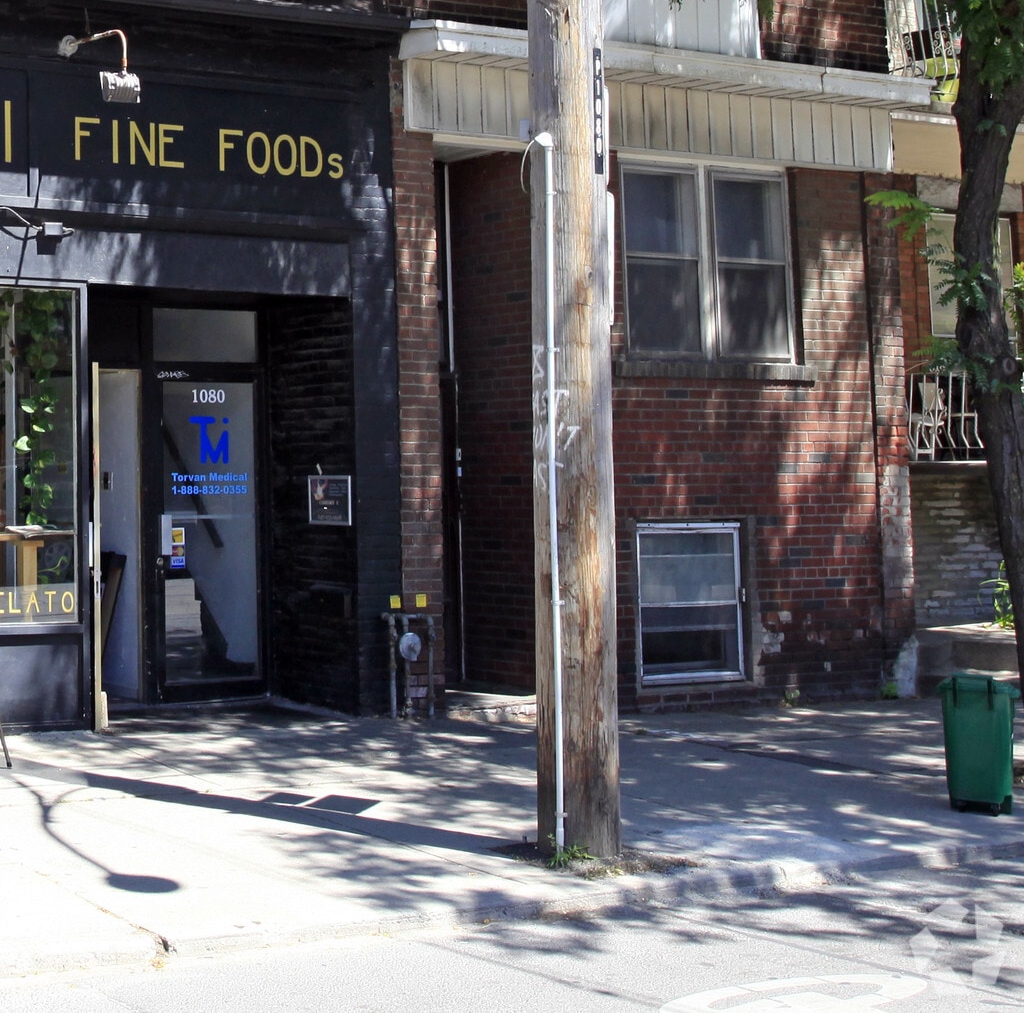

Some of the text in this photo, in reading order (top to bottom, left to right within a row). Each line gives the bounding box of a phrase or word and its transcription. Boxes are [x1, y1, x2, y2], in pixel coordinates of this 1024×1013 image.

[74, 116, 185, 168] FINE
[191, 389, 226, 404] 1080
[171, 472, 249, 482] Torvan Medical
[171, 485, 249, 495] 1-888-832-0355
